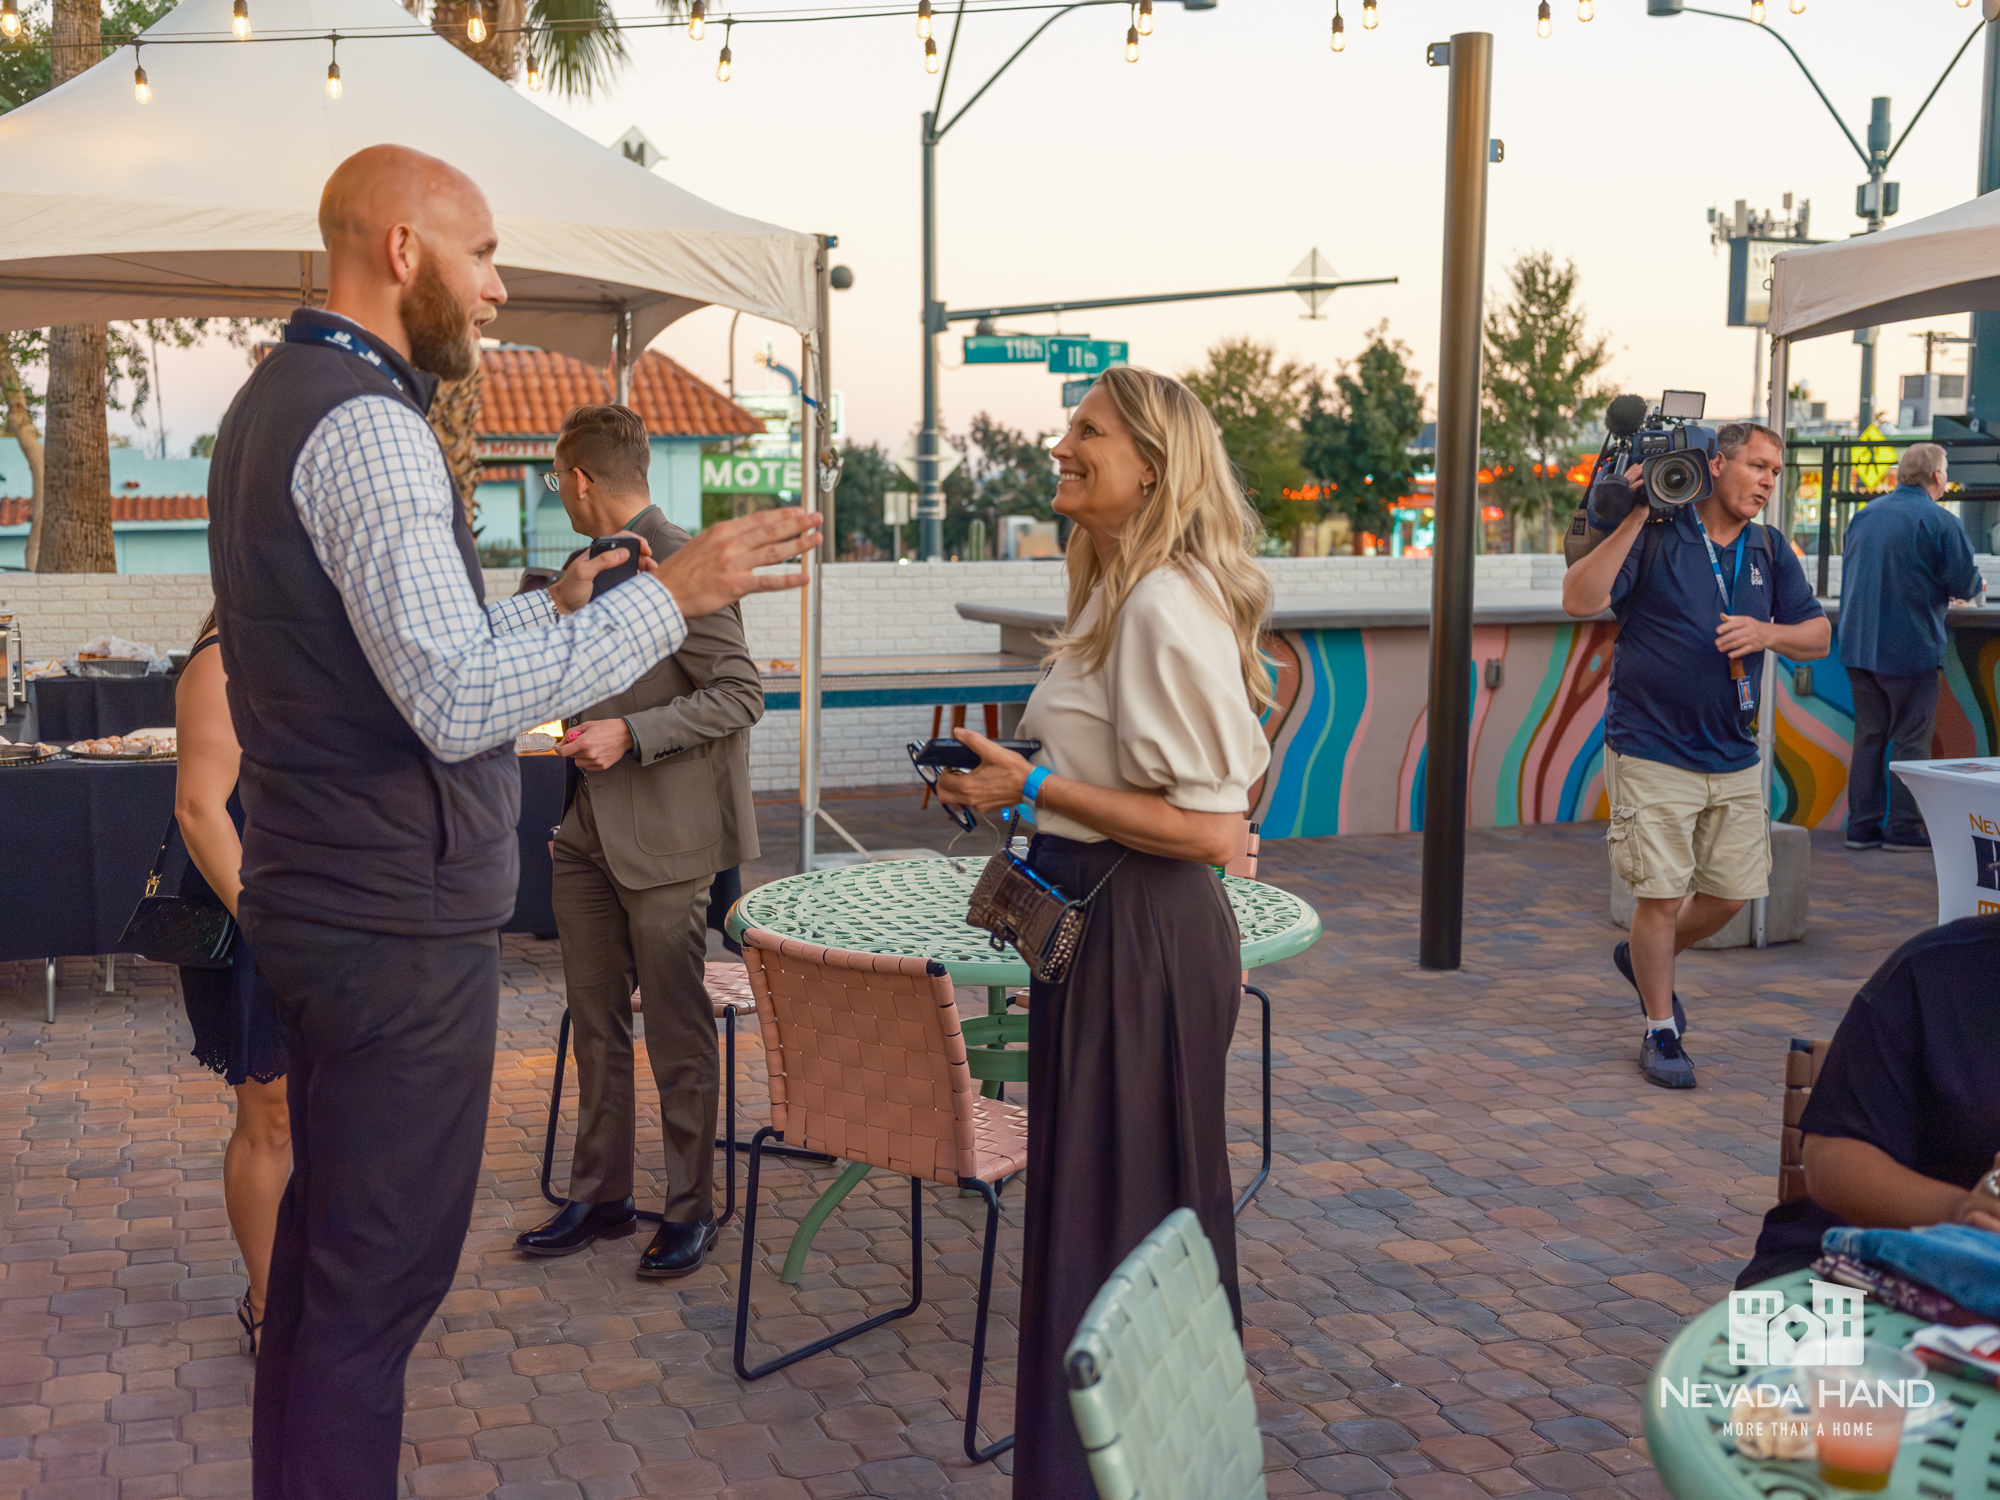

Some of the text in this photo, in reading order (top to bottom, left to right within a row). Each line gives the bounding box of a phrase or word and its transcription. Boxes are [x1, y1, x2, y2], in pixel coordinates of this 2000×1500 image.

[1005, 339, 1043, 359] 11th
[1068, 345, 1098, 368] 11th
[702, 459, 802, 489] MOTE
